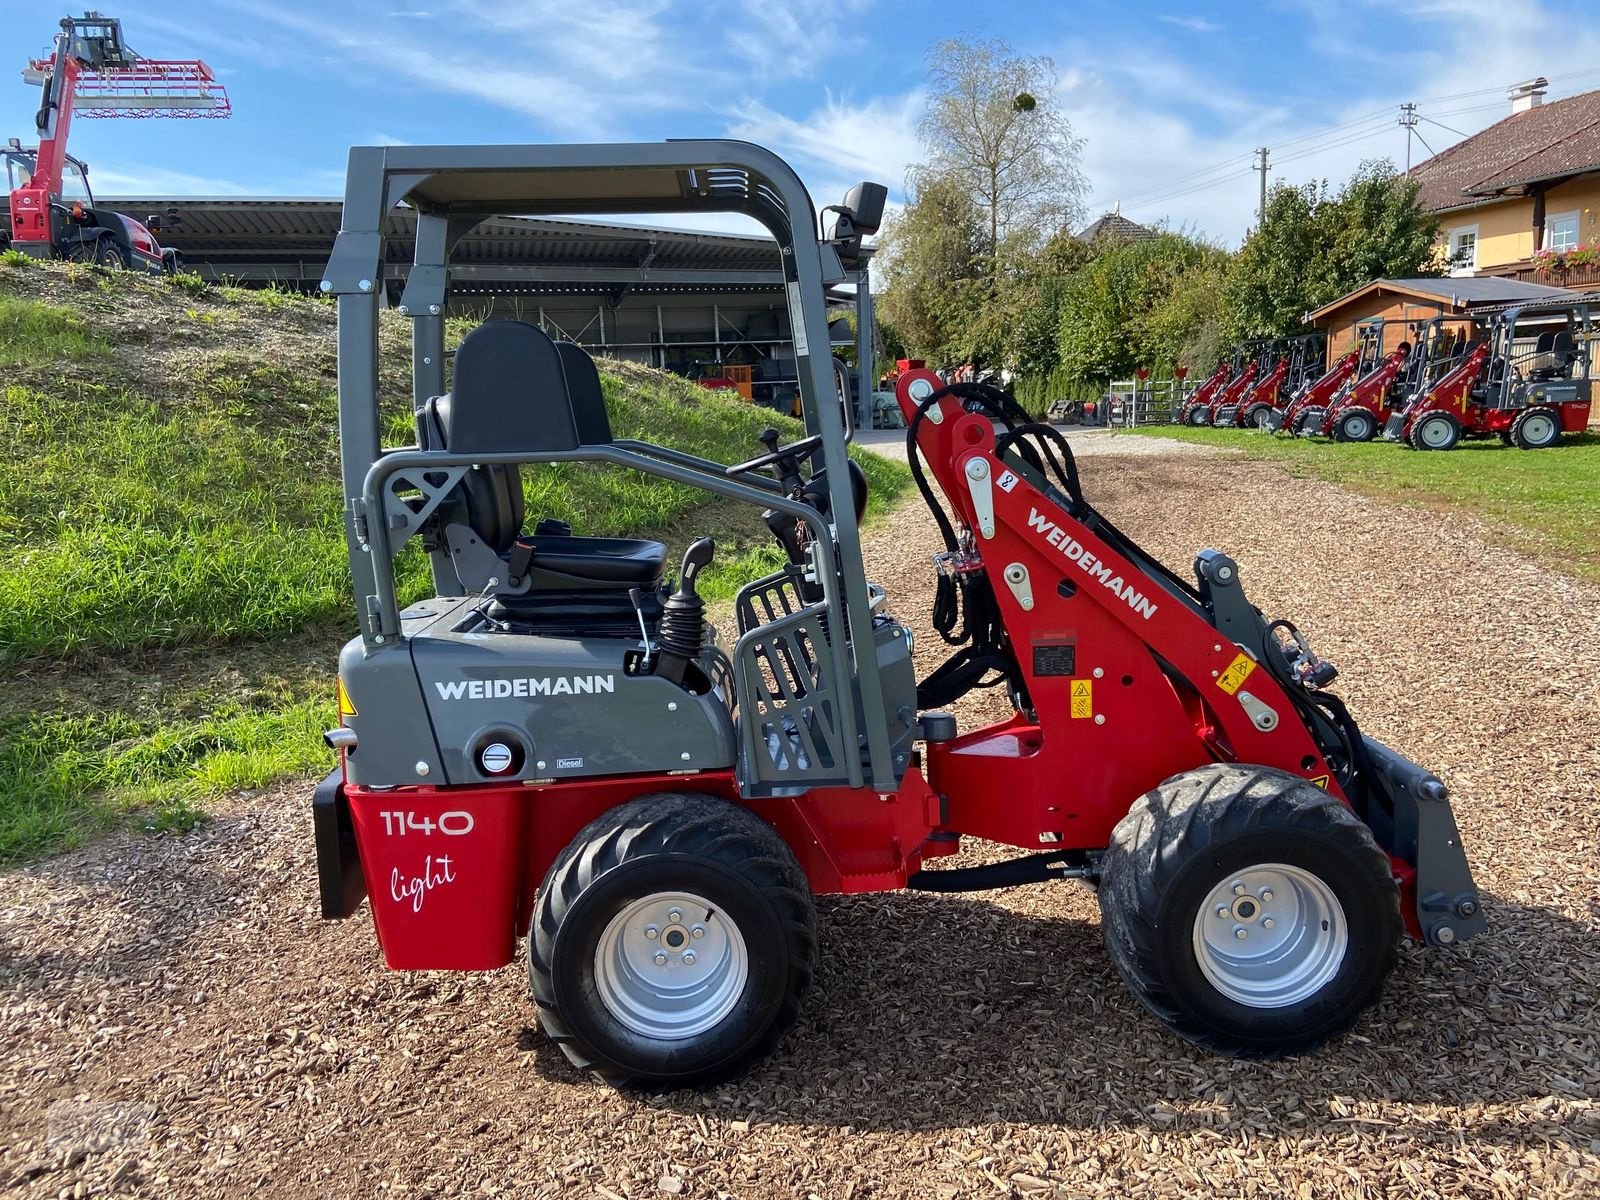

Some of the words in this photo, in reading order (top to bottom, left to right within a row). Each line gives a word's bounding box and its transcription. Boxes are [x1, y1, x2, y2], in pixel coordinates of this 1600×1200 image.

[1027, 507, 1159, 621] WEIDEMANN
[435, 675, 615, 700] WEIDEMANN
[558, 759, 581, 768] Diesel
[380, 811, 475, 836] 1140
[391, 854, 457, 913] light
